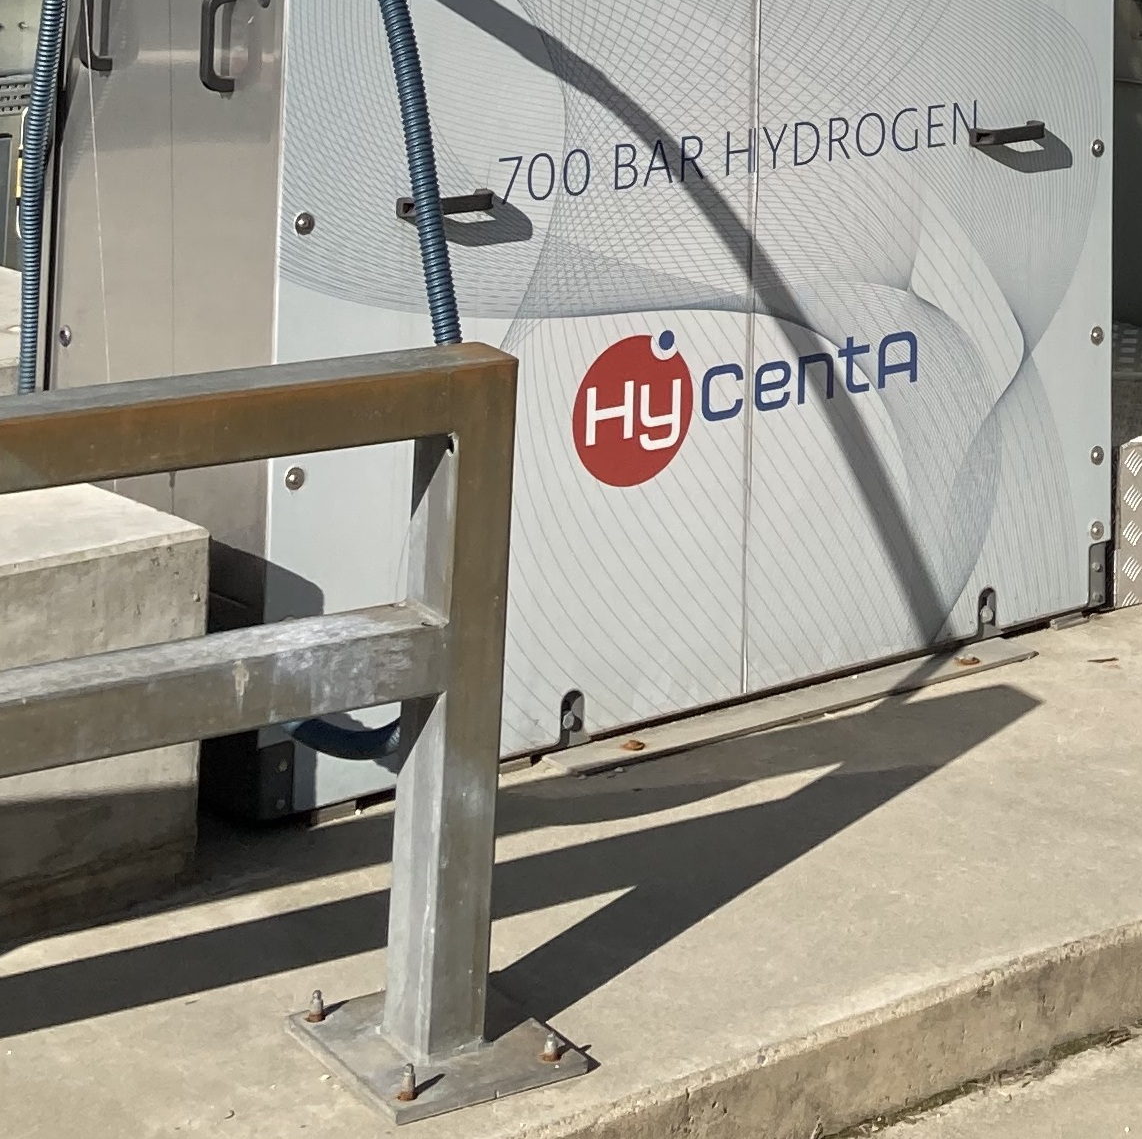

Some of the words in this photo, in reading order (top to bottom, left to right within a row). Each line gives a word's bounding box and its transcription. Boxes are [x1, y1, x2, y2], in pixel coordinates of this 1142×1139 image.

[499, 147, 591, 205] 700
[613, 135, 706, 191] BAR
[726, 99, 978, 177] HYDROGEN
[584, 329, 919, 452] HyCentA
